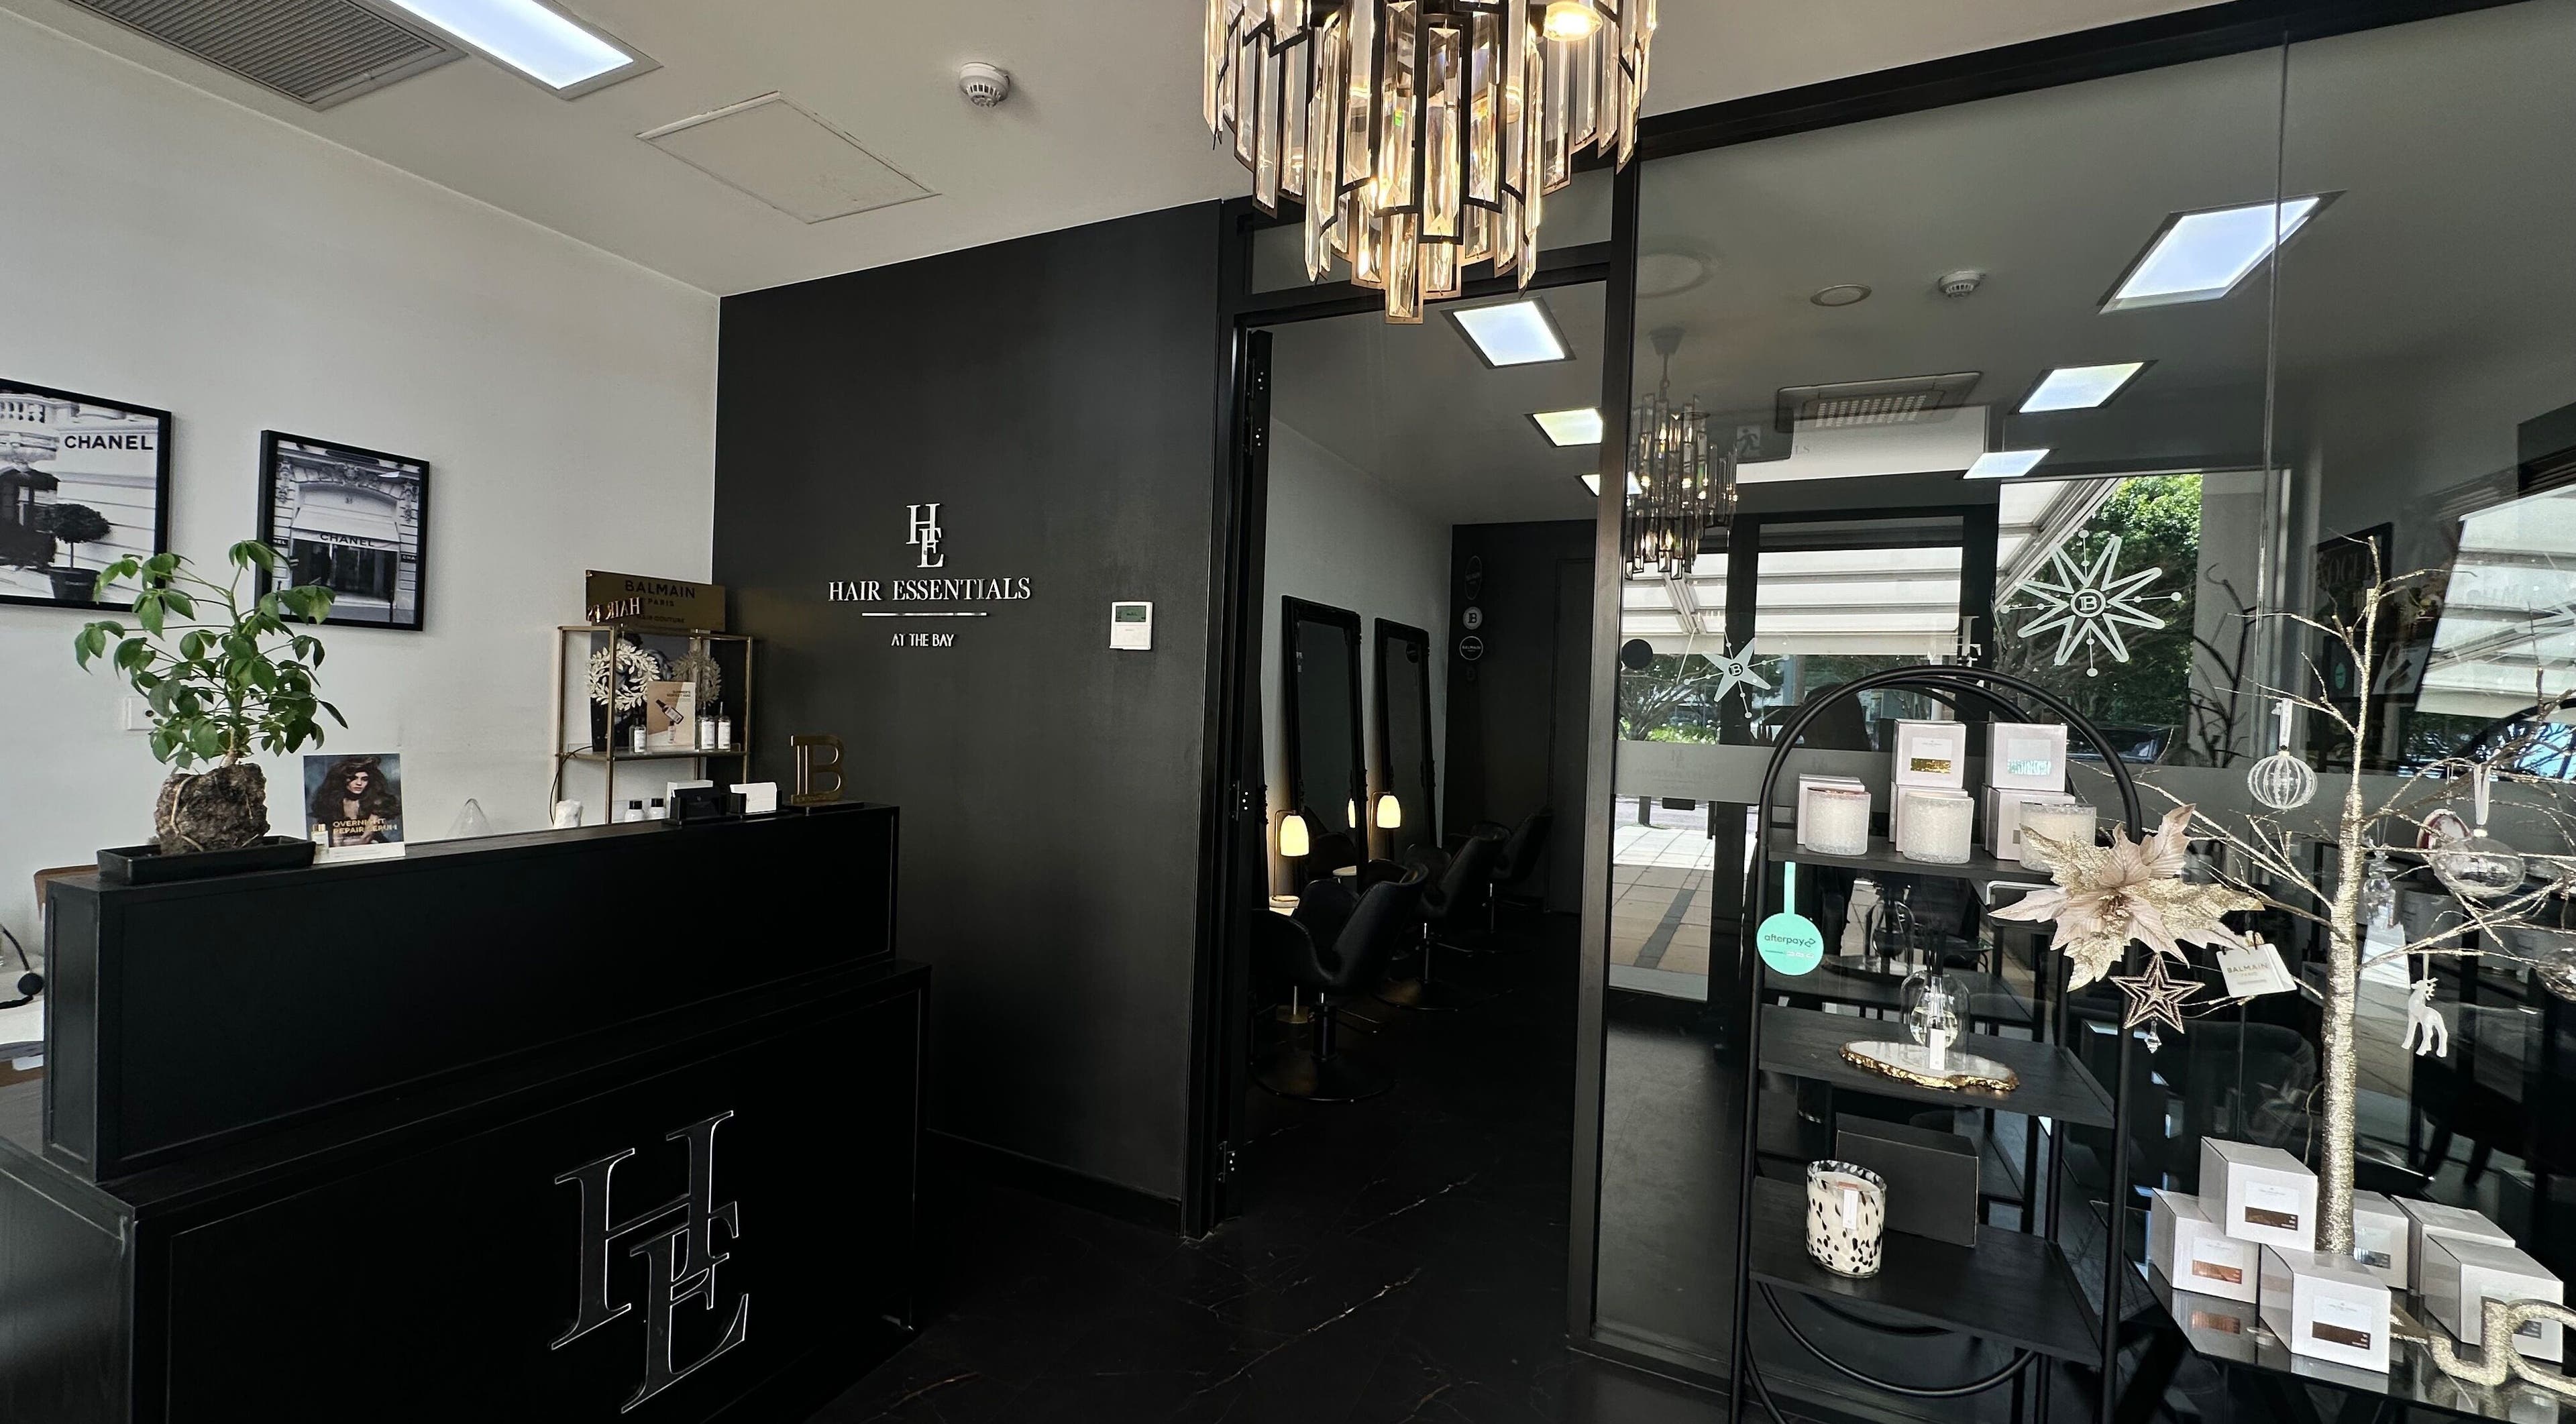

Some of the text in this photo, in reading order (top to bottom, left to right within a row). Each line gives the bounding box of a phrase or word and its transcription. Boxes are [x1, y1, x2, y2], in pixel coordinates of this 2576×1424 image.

[64, 434, 154, 451] CHANEL
[319, 533, 376, 547] CHANEL
[625, 580, 696, 599] BALMAIN
[828, 576, 1032, 602] HAIR ESSENTIALS
[648, 598, 675, 607] PARIS
[2079, 595, 2098, 611] B
[1467, 612, 1477, 624] B
[891, 633, 955, 647] AT THE BAY
[1729, 664, 1742, 676] B
[790, 734, 845, 805] B
[369, 824, 398, 832] ERUM
[1764, 934, 1805, 946] afterpay
[2226, 963, 2269, 973] BALMAIN
